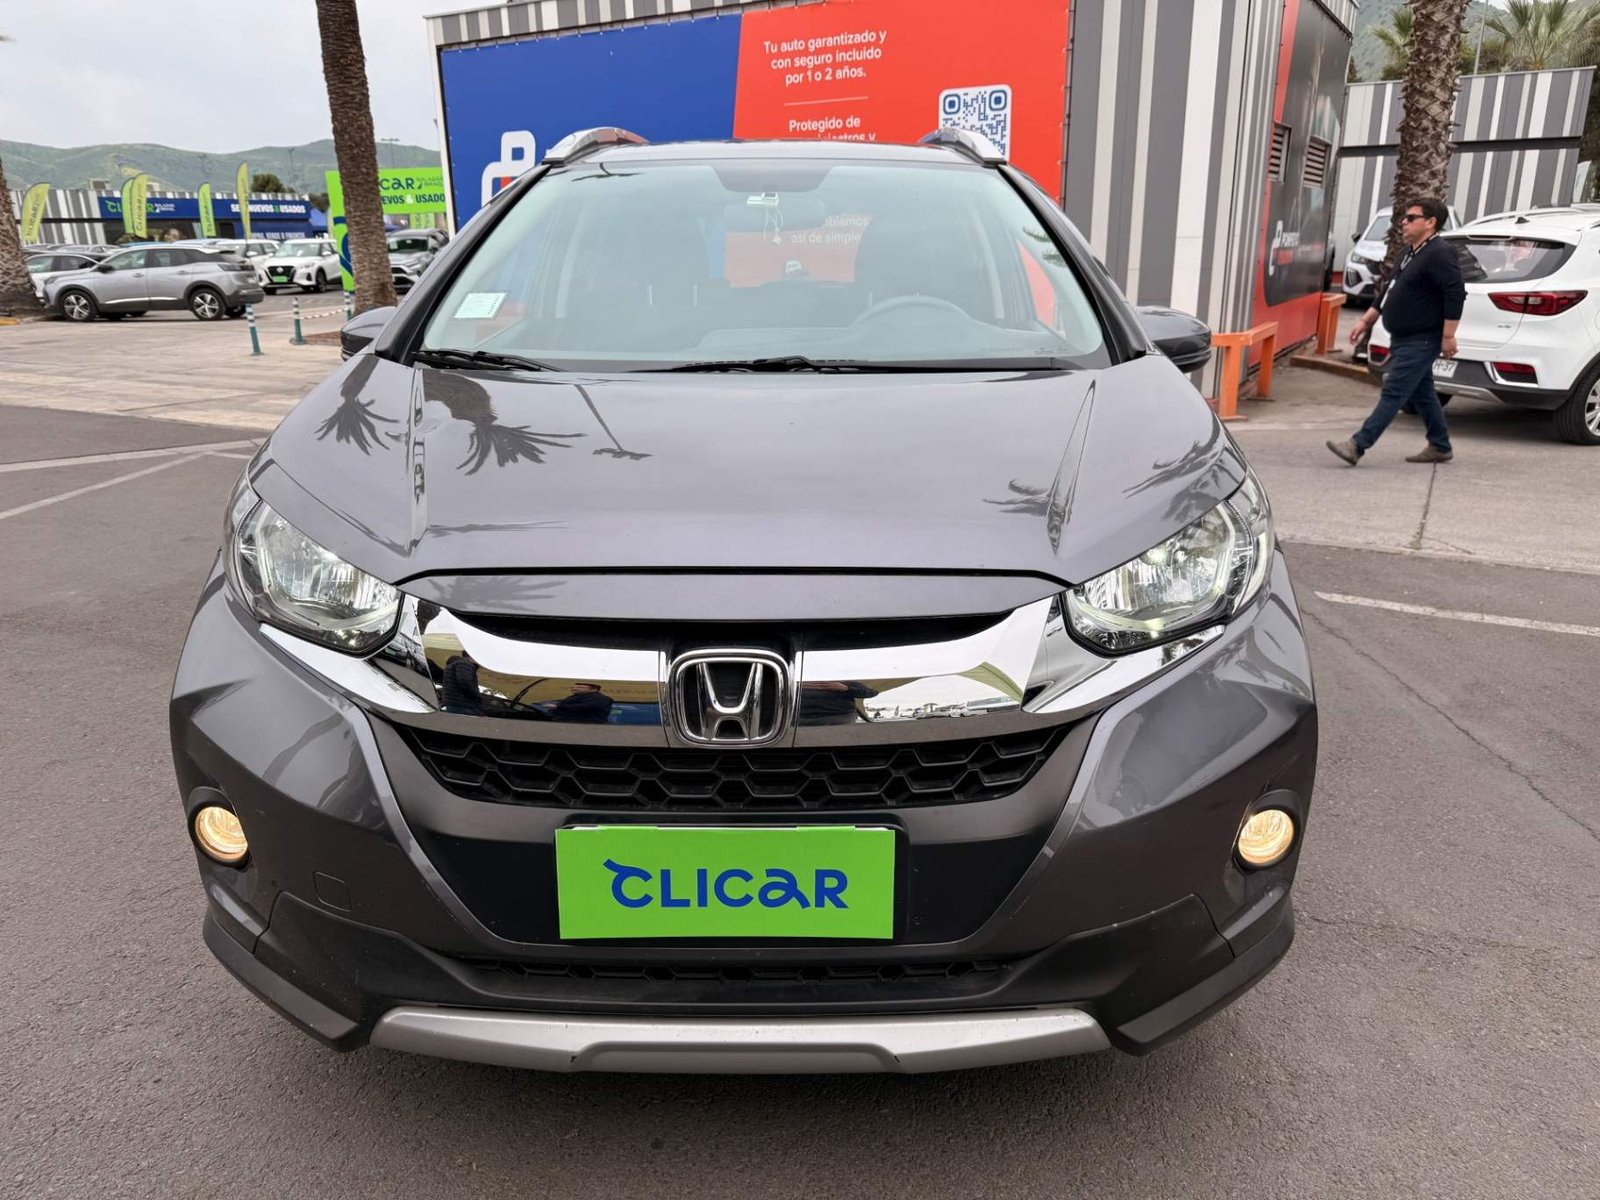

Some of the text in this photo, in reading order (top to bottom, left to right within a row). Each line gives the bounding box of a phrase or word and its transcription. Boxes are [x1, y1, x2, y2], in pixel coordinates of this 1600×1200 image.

[763, 30, 888, 54] Tu auto garantizado y
[771, 47, 882, 69] con seguro incluido
[785, 65, 867, 88] por 1 o 2 años.
[789, 115, 861, 132] Protegido de
[416, 193, 446, 203] USADO
